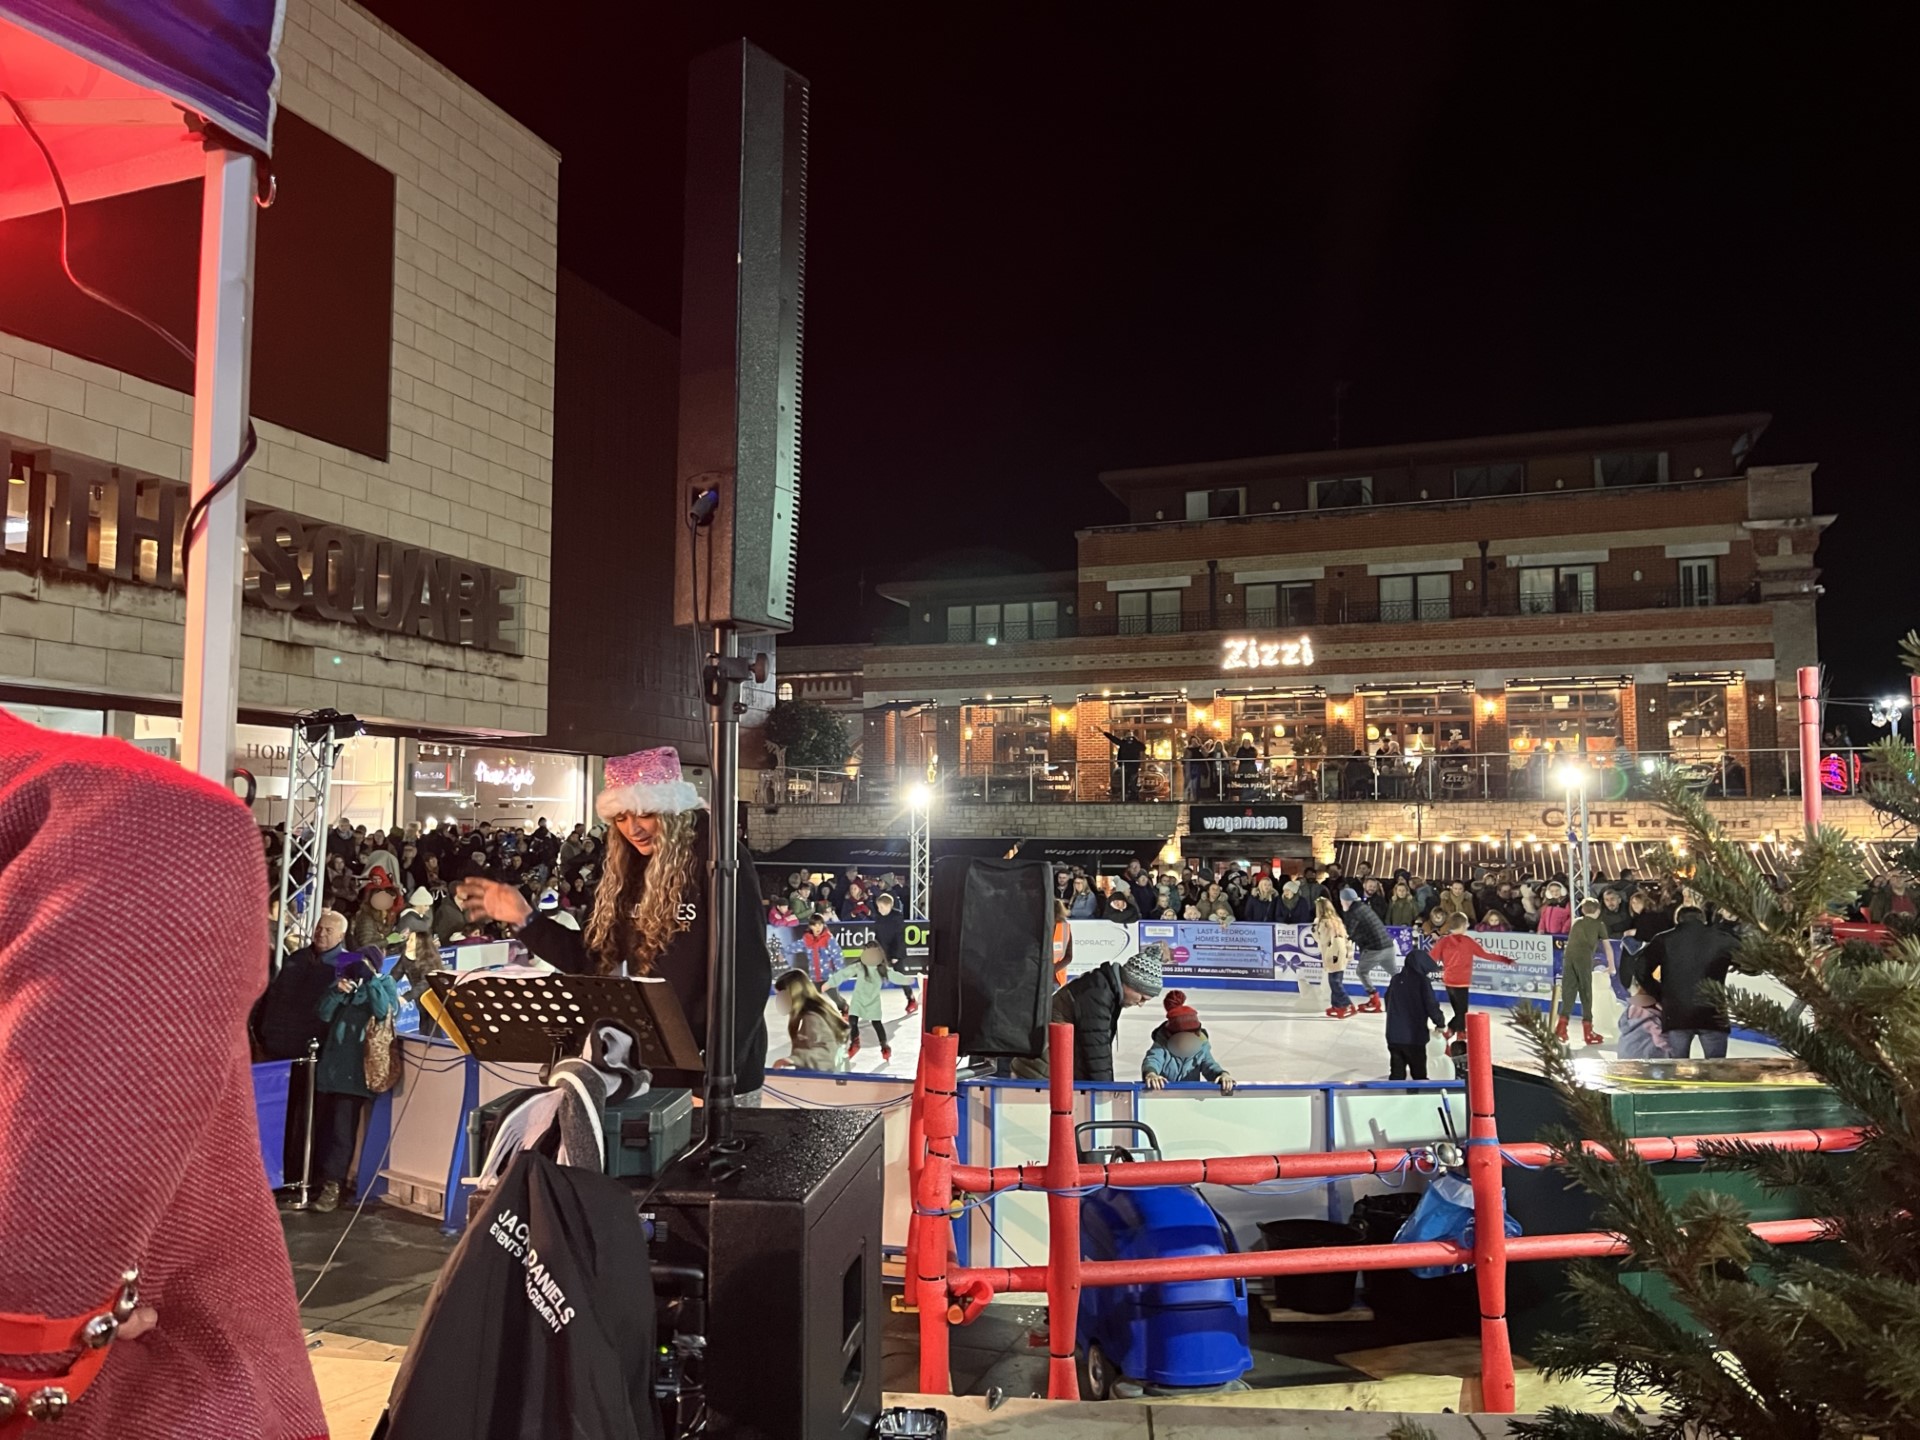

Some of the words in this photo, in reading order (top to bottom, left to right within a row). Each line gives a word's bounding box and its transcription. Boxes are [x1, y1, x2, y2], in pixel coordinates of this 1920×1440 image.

[0, 437, 188, 585] TH
[246, 502, 520, 658] SQUARE
[1222, 635, 1315, 670] Zizzi
[247, 743, 305, 761] HOB
[1203, 816, 1288, 833] wagamama
[1475, 937, 1547, 951] BUILDING
[1518, 966, 1548, 974] FIT-OUTS
[489, 1222, 524, 1257] EVENTS
[528, 1248, 575, 1325] DANIELS
